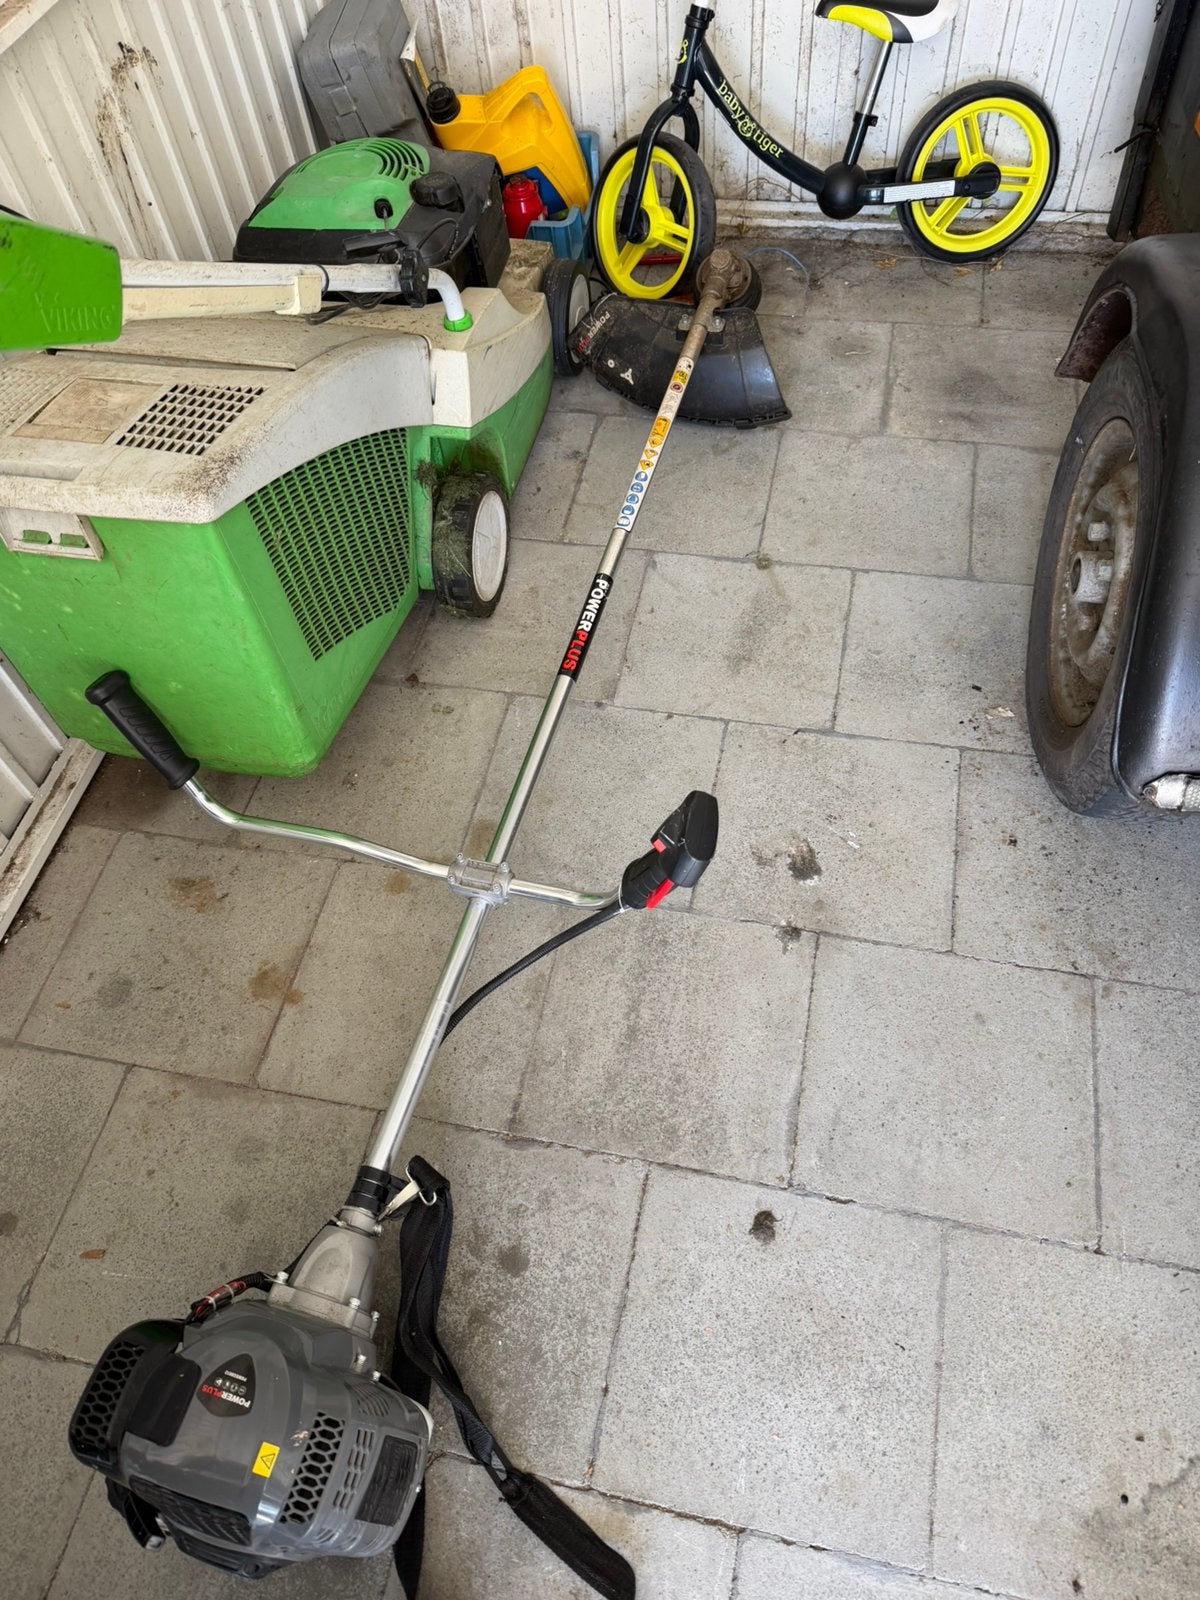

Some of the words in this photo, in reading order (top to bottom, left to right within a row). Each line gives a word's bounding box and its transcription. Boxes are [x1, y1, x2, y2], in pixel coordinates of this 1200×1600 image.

[718, 80, 746, 119] baby
[753, 131, 784, 158] tiger
[40, 306, 113, 333] VIKING
[563, 579, 610, 672] POWERPLUS
[202, 1384, 251, 1408] POWERPLUS
